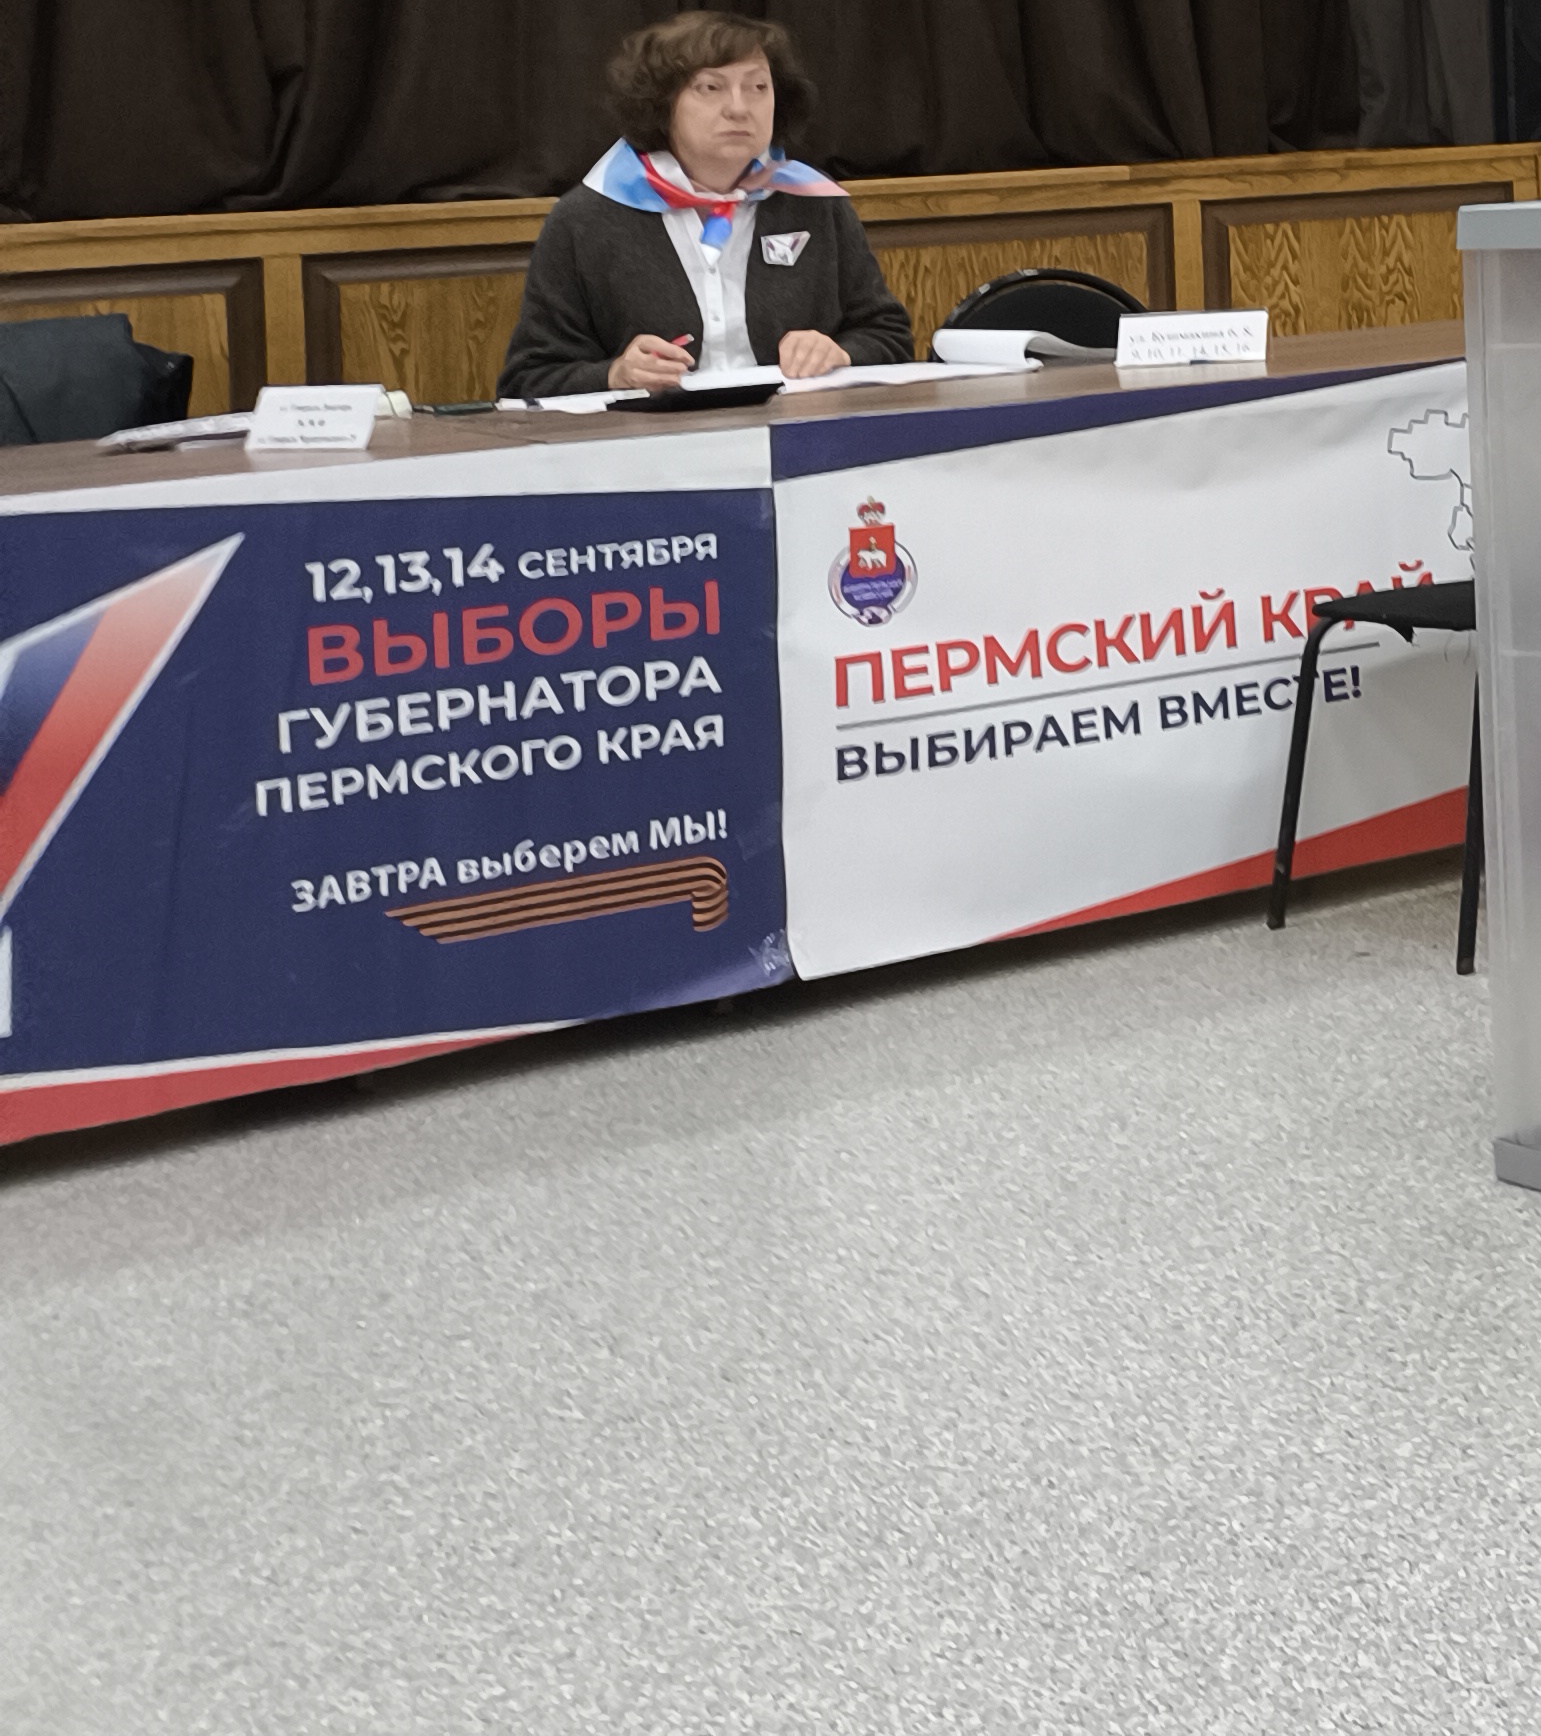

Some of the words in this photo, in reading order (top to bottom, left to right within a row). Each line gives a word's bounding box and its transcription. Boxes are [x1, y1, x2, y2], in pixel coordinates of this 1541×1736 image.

[305, 544, 504, 602] 12,13,14
[518, 533, 718, 579] СЕНТЯБРЯ
[307, 580, 720, 685] ВЫБОРЫ
[835, 588, 1237, 707] ПЕРМСКИЙ
[279, 657, 722, 753] ГУБЕРНАТОРА
[836, 702, 1141, 781] ВЫБИРАЕМ
[256, 736, 582, 816] ПЕРМСКОГО
[598, 715, 723, 764] КРАЯ
[291, 857, 447, 912] ЗАВТРА
[458, 831, 640, 884] выберем
[650, 809, 727, 849] МЫ!
